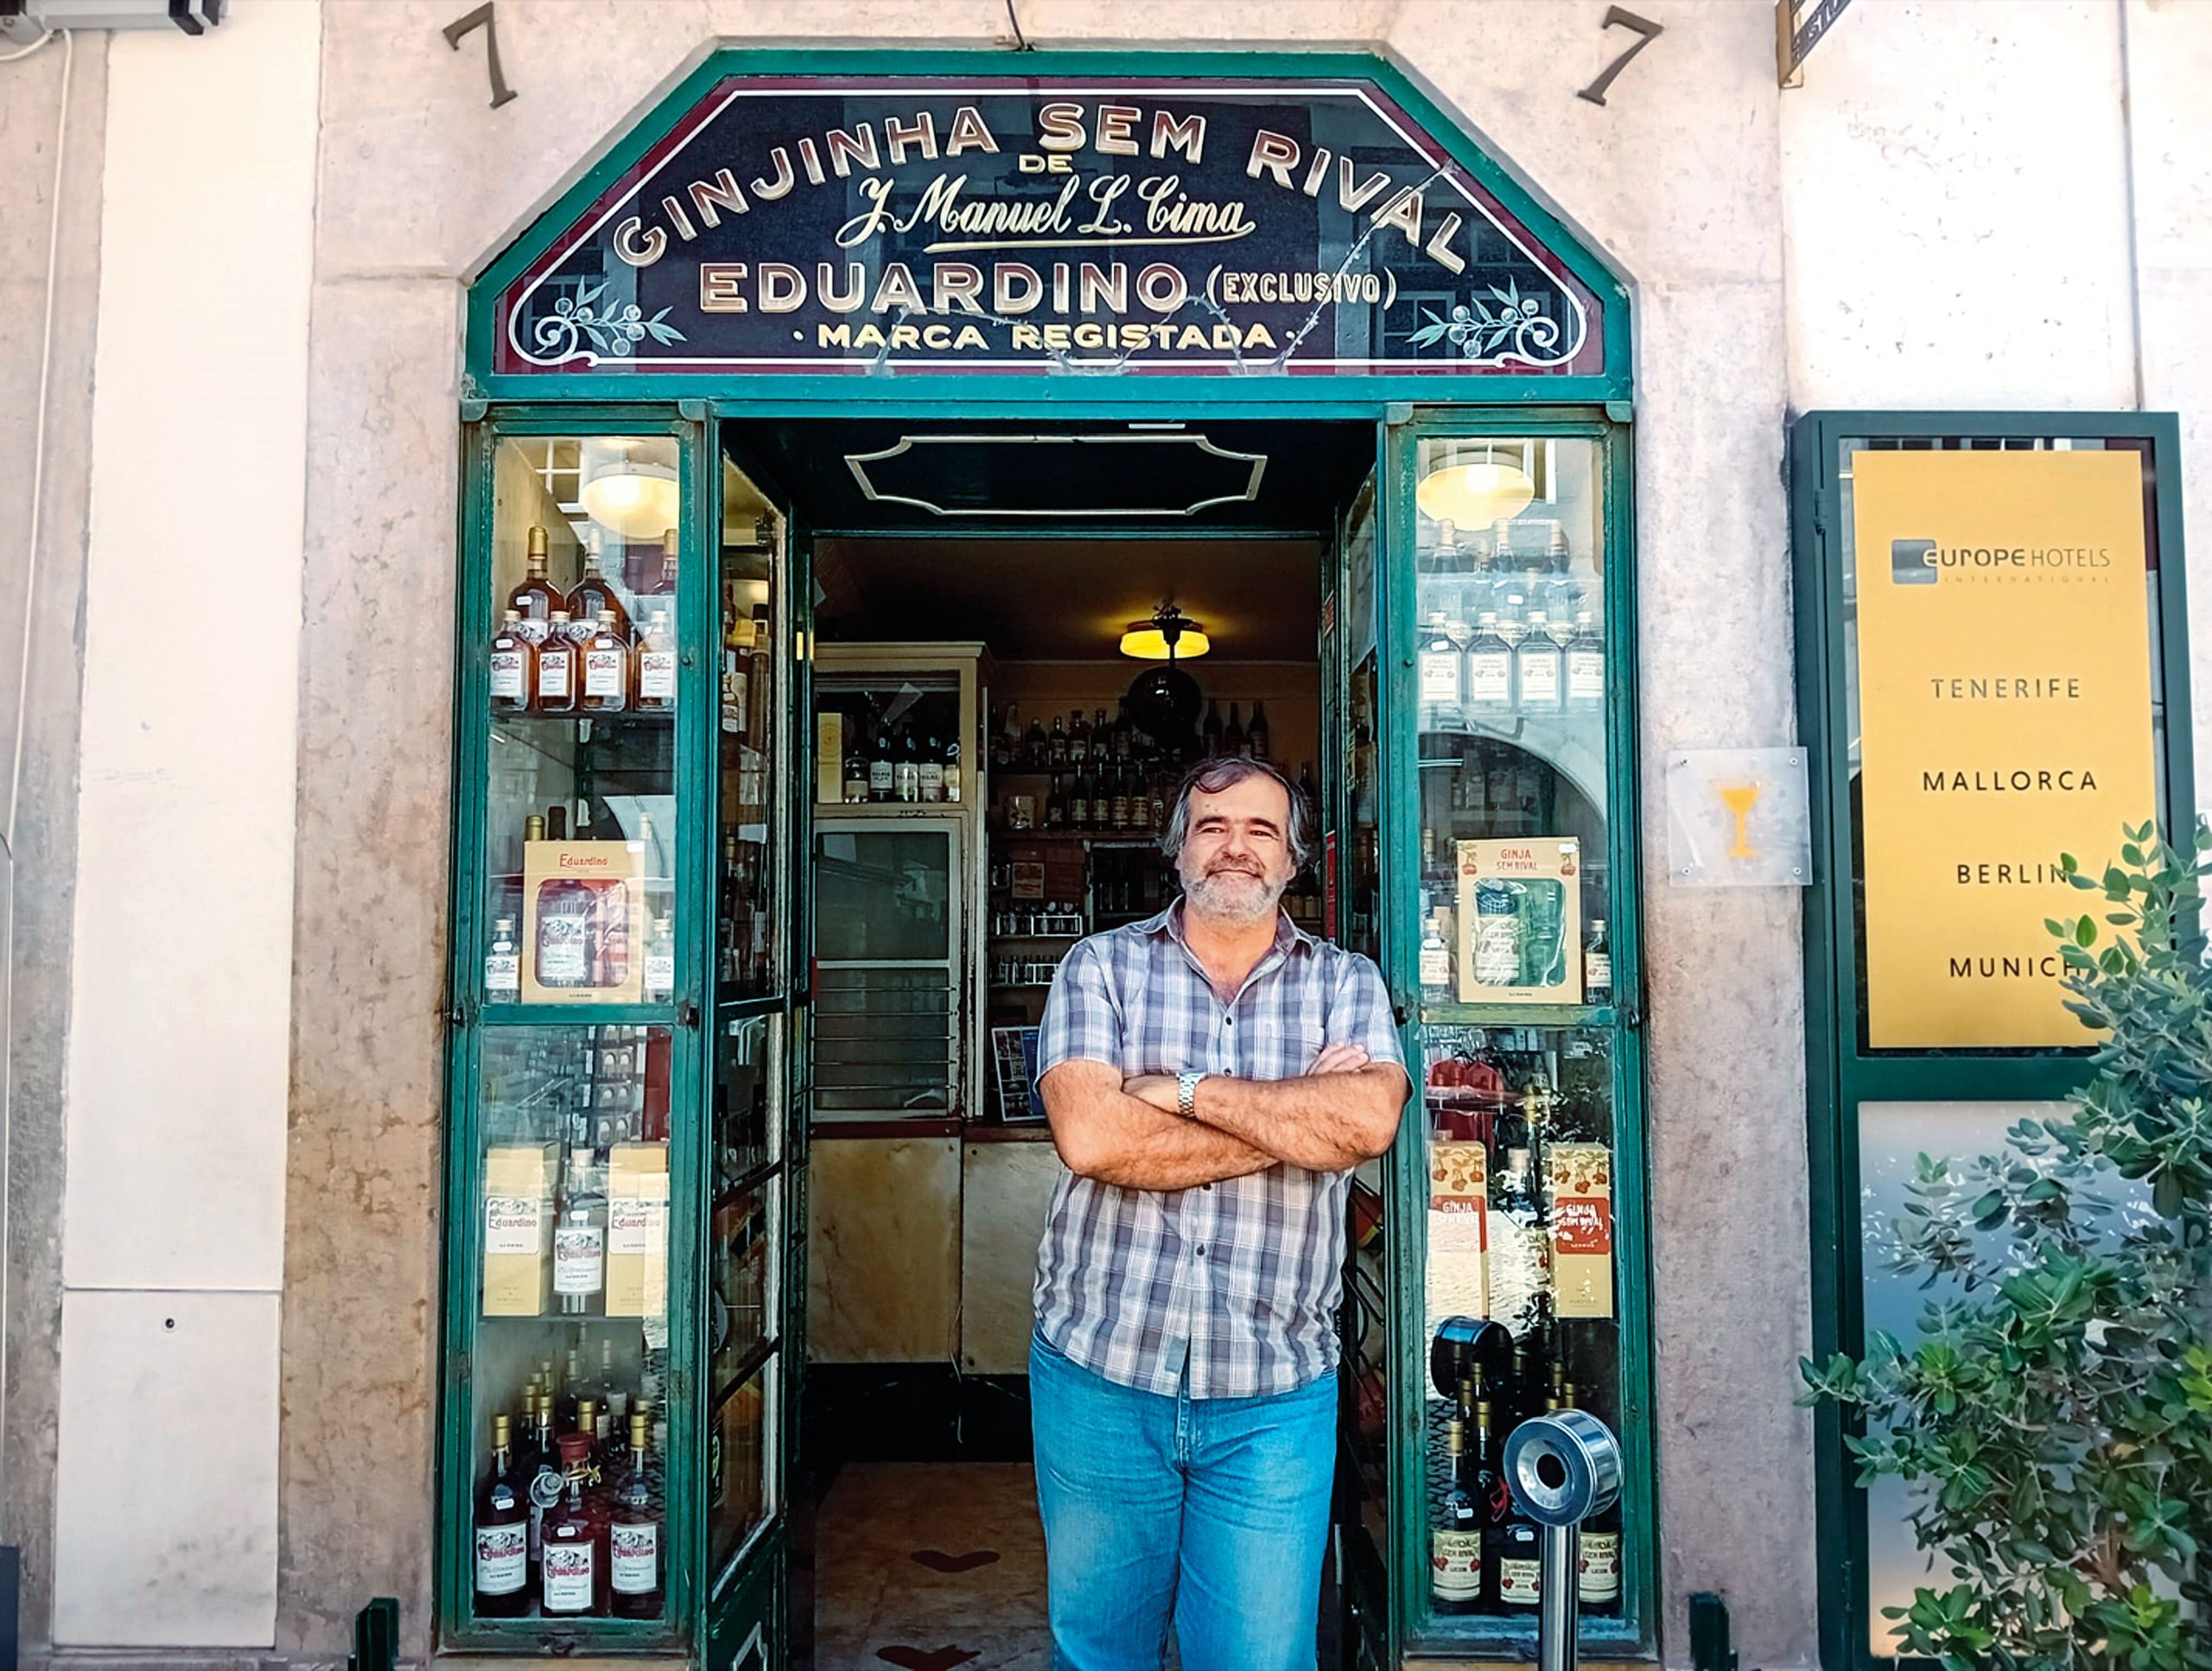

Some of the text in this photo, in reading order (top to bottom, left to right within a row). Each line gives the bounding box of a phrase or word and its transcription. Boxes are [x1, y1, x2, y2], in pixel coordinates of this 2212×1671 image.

[442, 1, 518, 109] 7
[1577, 4, 1663, 105] 7
[1019, 154, 1073, 173] DE
[613, 103, 1466, 276] GINJINHA SEM RIVAL
[893, 173, 1080, 234] Manuel
[1077, 174, 1133, 234] L.
[1137, 175, 1256, 233] Cima
[699, 262, 1396, 314] EDUARDINO (EXCLUSIVO)
[817, 323, 1277, 350] MARCA REGISTADA
[2031, 548, 2111, 568] HOTELS
[1930, 678, 2081, 699] TENERIFE
[1922, 771, 2099, 791] MALLORCA
[559, 853, 609, 868] Eduardino
[1501, 848, 1532, 860] GINJA
[1957, 864, 2069, 884] BERLIN
